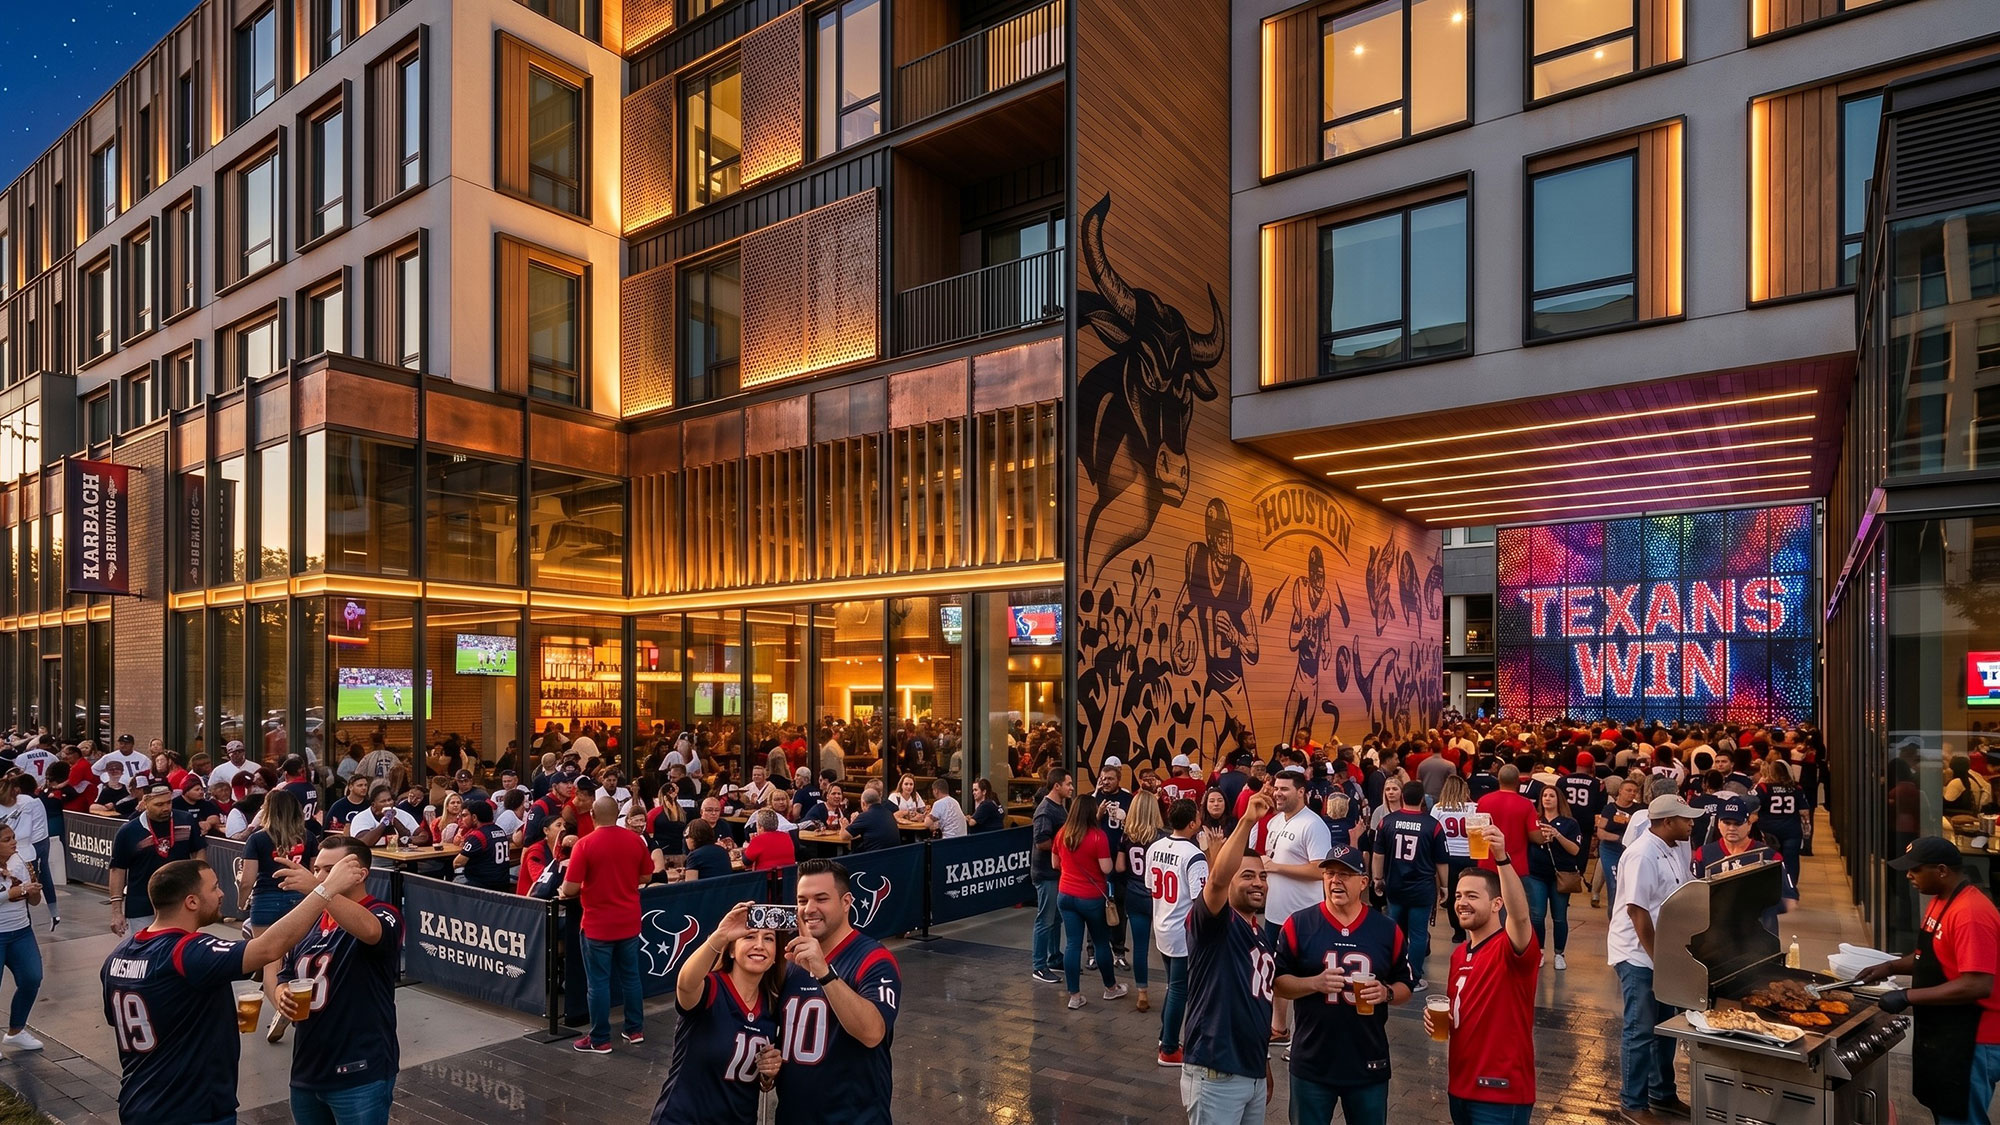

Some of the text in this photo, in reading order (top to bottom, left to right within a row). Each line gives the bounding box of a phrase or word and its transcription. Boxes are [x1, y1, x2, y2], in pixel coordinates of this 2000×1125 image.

[83, 473, 100, 580] KARBACH
[106, 499, 117, 562] BREWING
[1261, 487, 1352, 553] HOUSTON
[1521, 576, 1788, 638] TEXANS
[1576, 641, 1731, 698] WIN
[1566, 786, 1590, 807] 39
[1770, 796, 1795, 814] 23
[69, 832, 113, 857] KARBACH
[1394, 833, 1419, 861] 13
[945, 850, 1031, 884] KARBACH
[961, 875, 1015, 897] BREWING
[1151, 867, 1179, 904] 30
[419, 910, 527, 959] KARBACH
[438, 946, 504, 975] BREWING
[878, 985, 897, 1010] 10
[112, 991, 155, 1051] 19
[782, 996, 829, 1065] 10
[725, 1031, 769, 1082] 10
